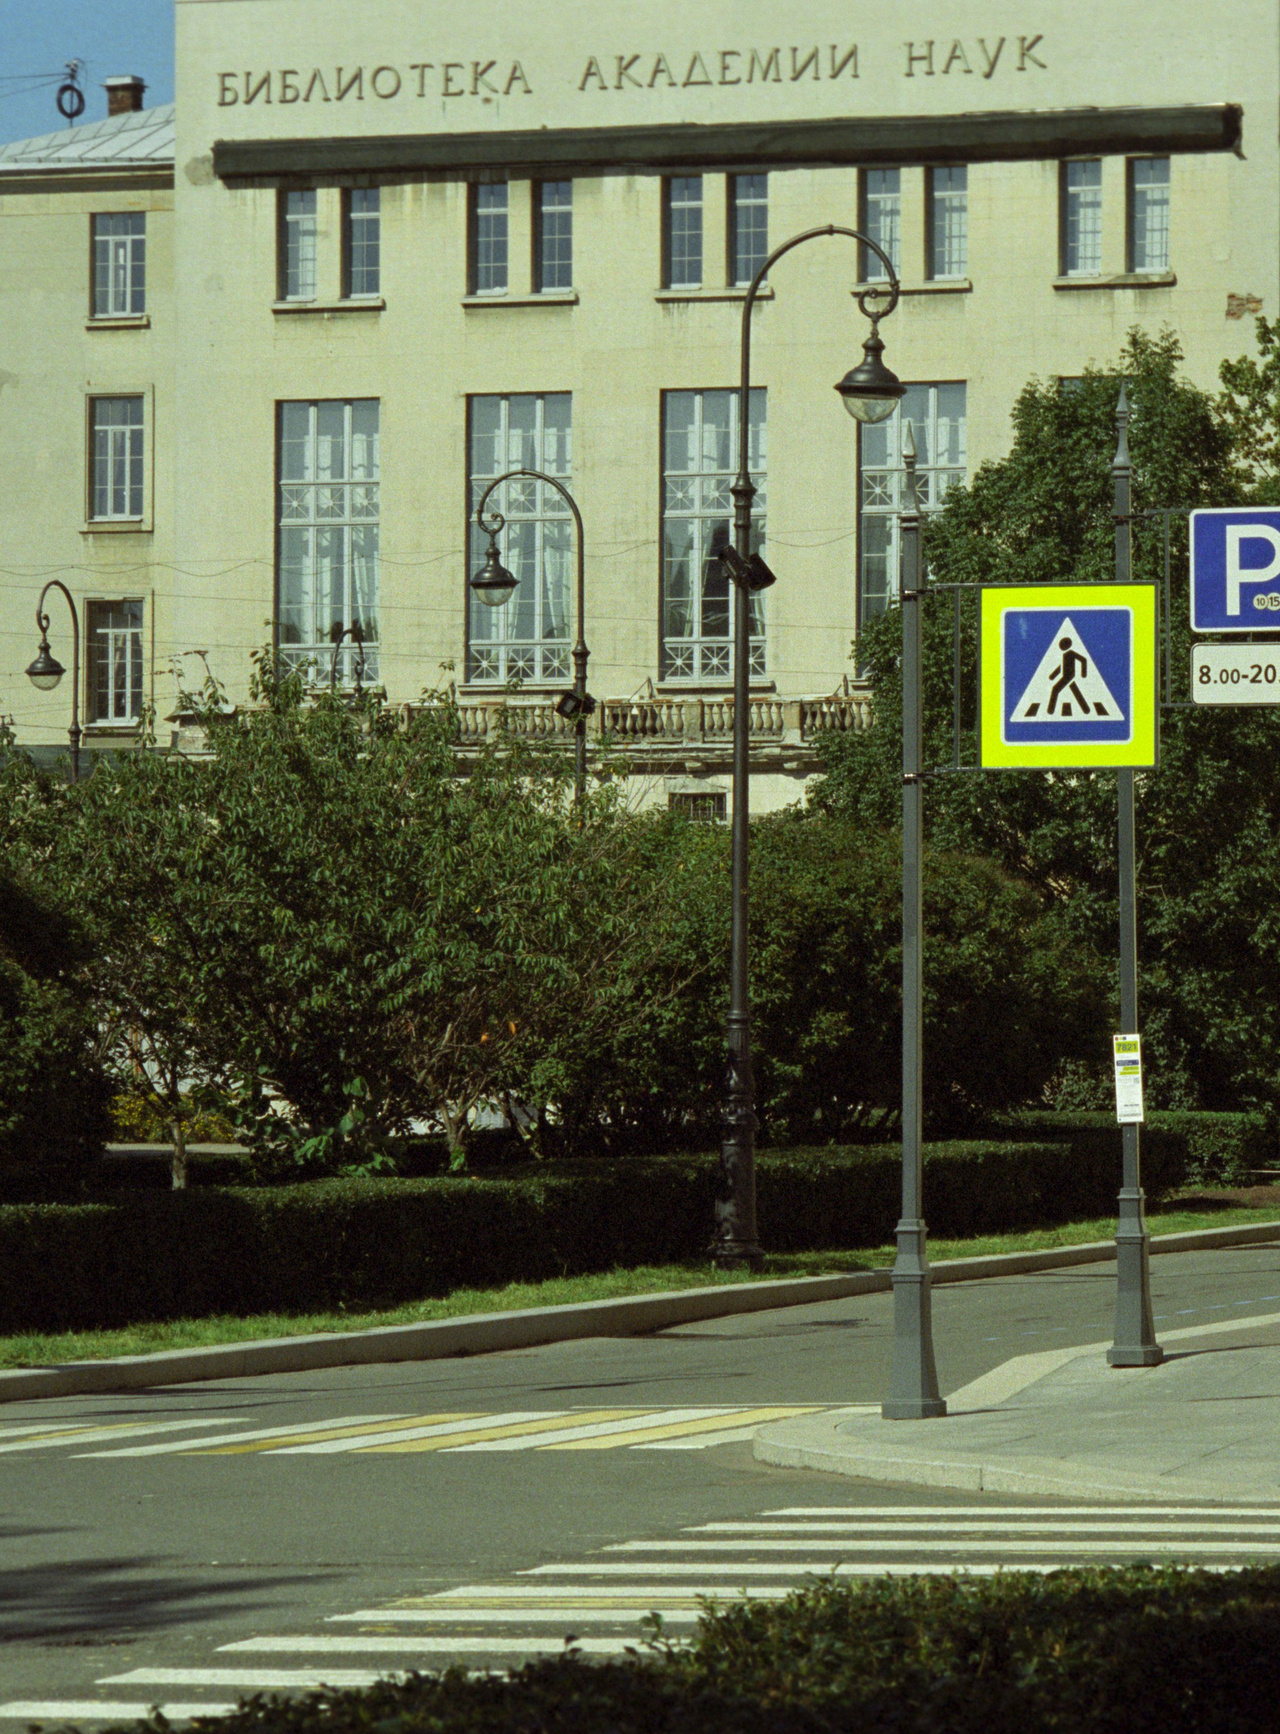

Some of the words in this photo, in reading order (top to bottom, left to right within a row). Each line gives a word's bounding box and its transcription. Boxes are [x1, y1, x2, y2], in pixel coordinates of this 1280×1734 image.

[217, 60, 533, 107] БИБЛИОТЕКА
[578, 44, 860, 91] АКАДЕМИИ
[903, 34, 1048, 79] НАУК
[1256, 597, 1266, 606] 10
[1269, 596, 1280, 607] 15
[1116, 1043, 1137, 1052] 7821
